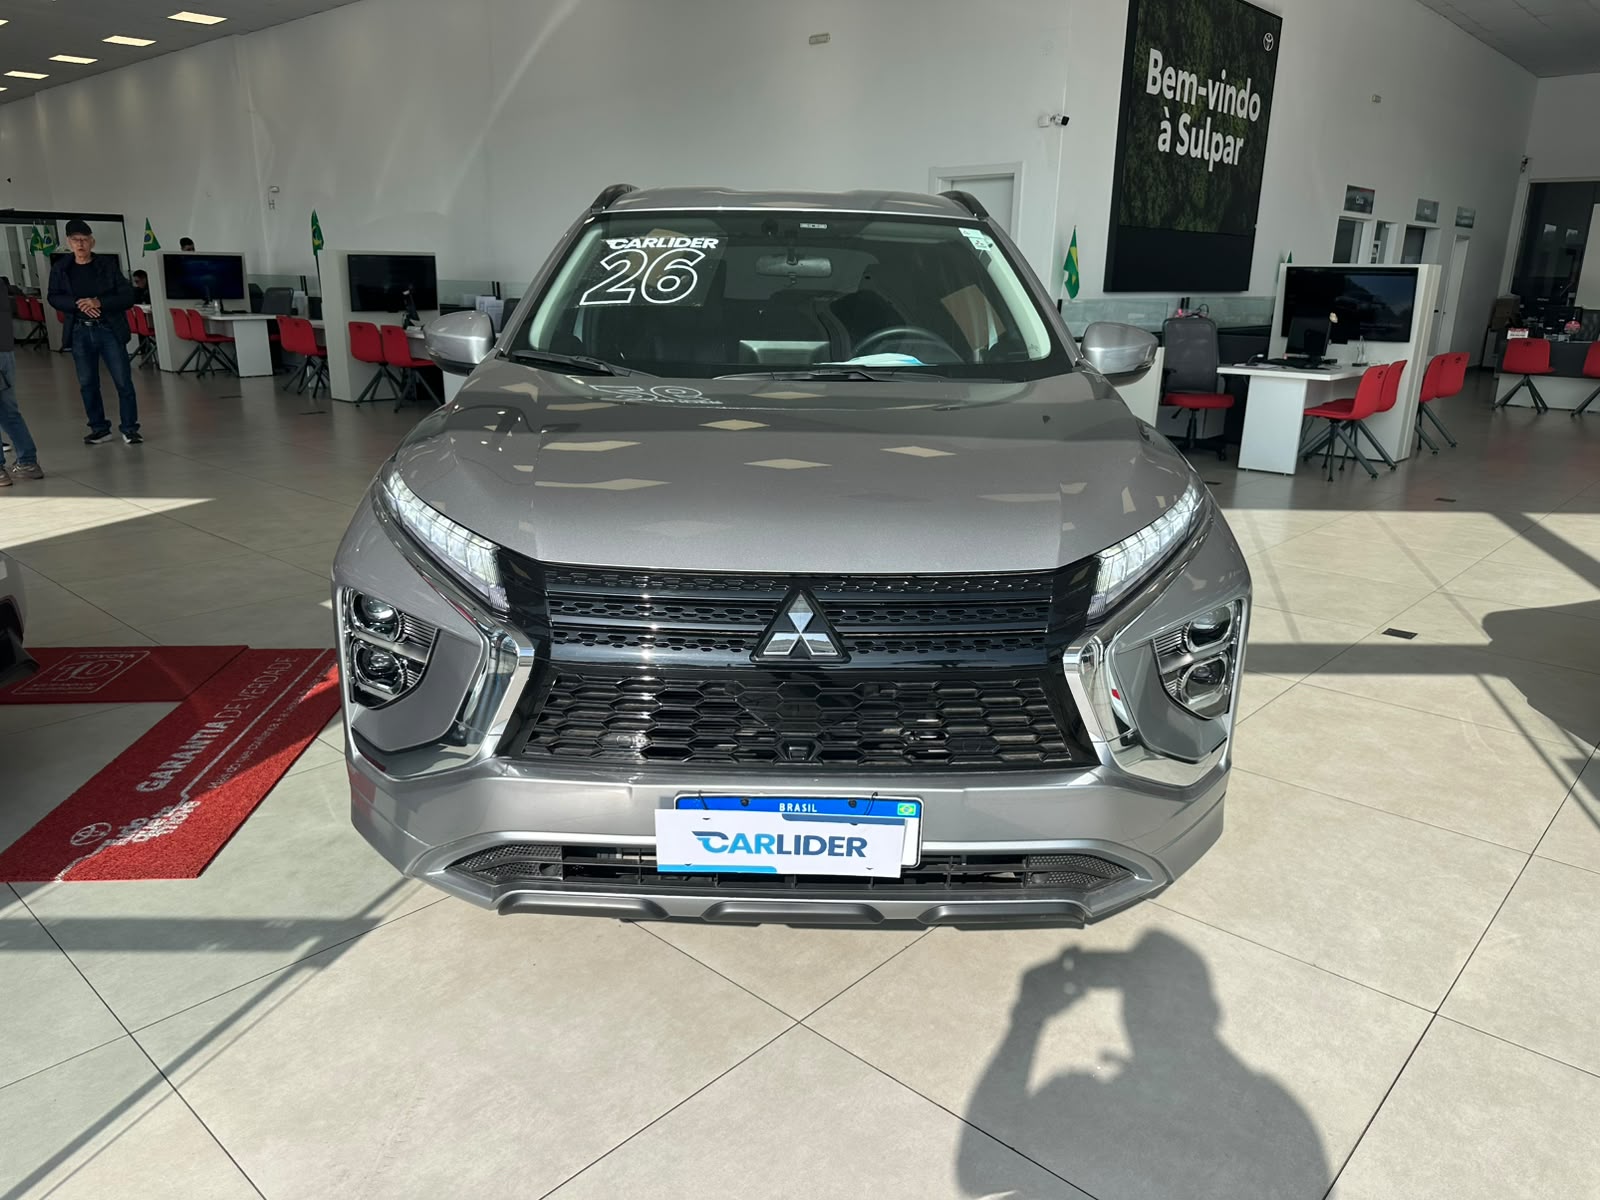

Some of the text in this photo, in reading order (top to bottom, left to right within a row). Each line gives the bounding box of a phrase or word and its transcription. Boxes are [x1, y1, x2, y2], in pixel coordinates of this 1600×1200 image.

[1146, 48, 1261, 122] Bem-vindo
[1157, 106, 1244, 173] à Sulpar
[606, 237, 719, 249] CARLIDER
[579, 247, 706, 305] 26
[231, 657, 300, 702] VERDADE
[213, 703, 252, 719] DE
[135, 719, 235, 793] GARANTIA
[779, 802, 818, 813] BRASIL
[691, 831, 868, 858] CARLIDER
